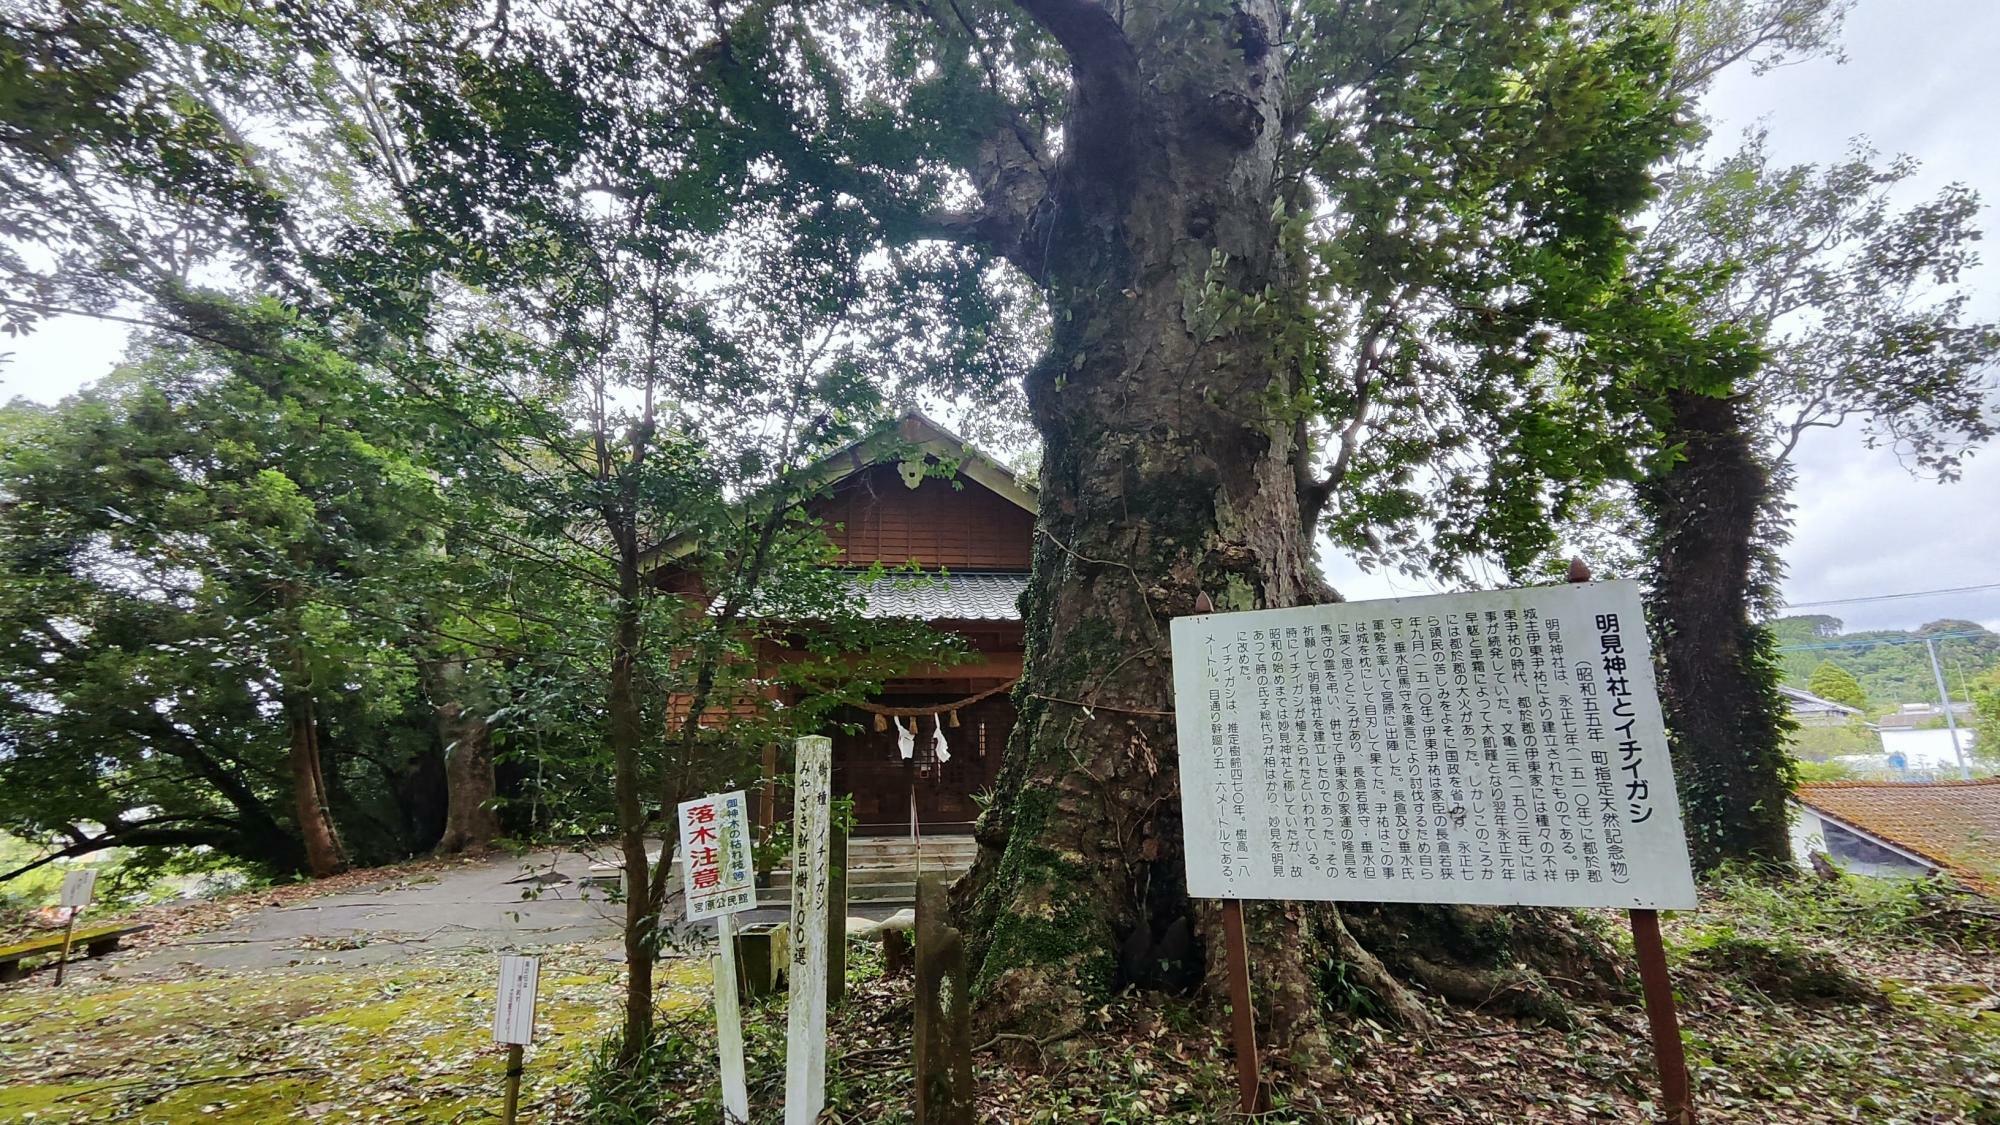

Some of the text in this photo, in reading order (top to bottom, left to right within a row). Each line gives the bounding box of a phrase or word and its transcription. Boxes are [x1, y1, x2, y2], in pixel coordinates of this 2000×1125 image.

[1236, 631, 1252, 681] に改めた。
[1594, 613, 1653, 824] 明見神社とイチイガシ
[1574, 660, 1630, 884] （昭和五五年 町指定天然記念物）
[687, 804, 721, 890] 落木注意
[726, 798, 746, 883] 御神木の枯れ枝等
[794, 761, 811, 967] みやざき新巨樹100選
[815, 828, 827, 912] イチイガシ
[693, 893, 749, 914] 宮原公民館
